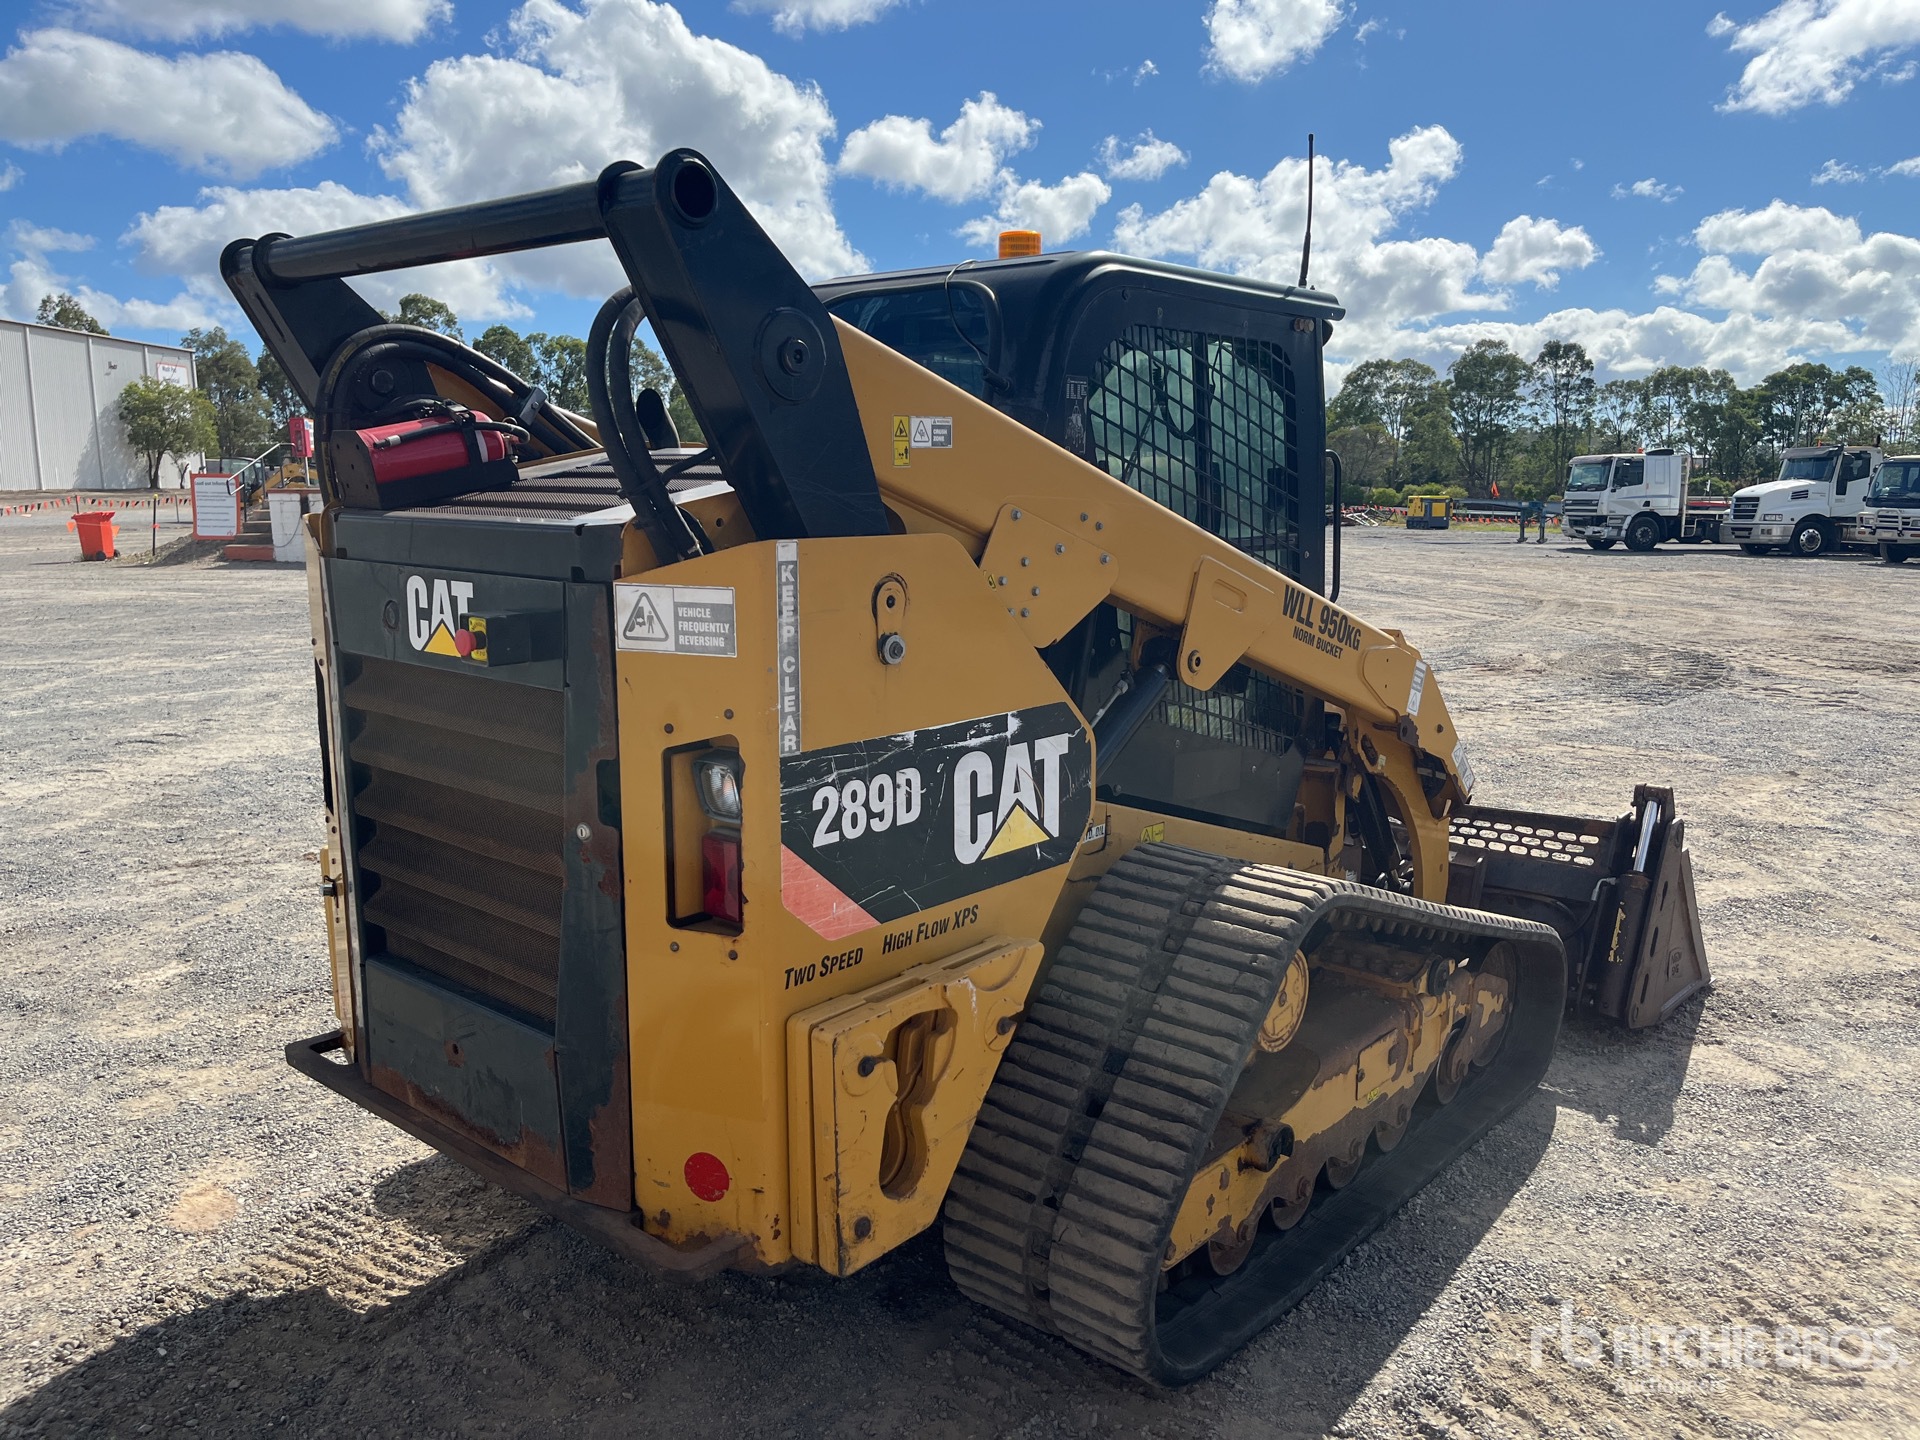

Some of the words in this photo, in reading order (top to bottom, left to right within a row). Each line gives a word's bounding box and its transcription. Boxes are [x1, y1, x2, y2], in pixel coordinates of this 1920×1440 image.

[406, 574, 474, 651] CAT
[677, 606, 712, 618] VEHICLE
[678, 620, 730, 634] FREQUENTLY
[780, 564, 795, 643] KEEP
[1282, 583, 1314, 629] WLL
[1318, 604, 1362, 651] 950KG
[679, 634, 725, 648] REVERSING
[1292, 625, 1316, 647] NORM
[1315, 636, 1344, 660] BUCKET
[782, 655, 797, 752] CLEAR
[812, 767, 922, 849] 289D
[953, 732, 1069, 865] CAT
[952, 904, 979, 931] XPS
